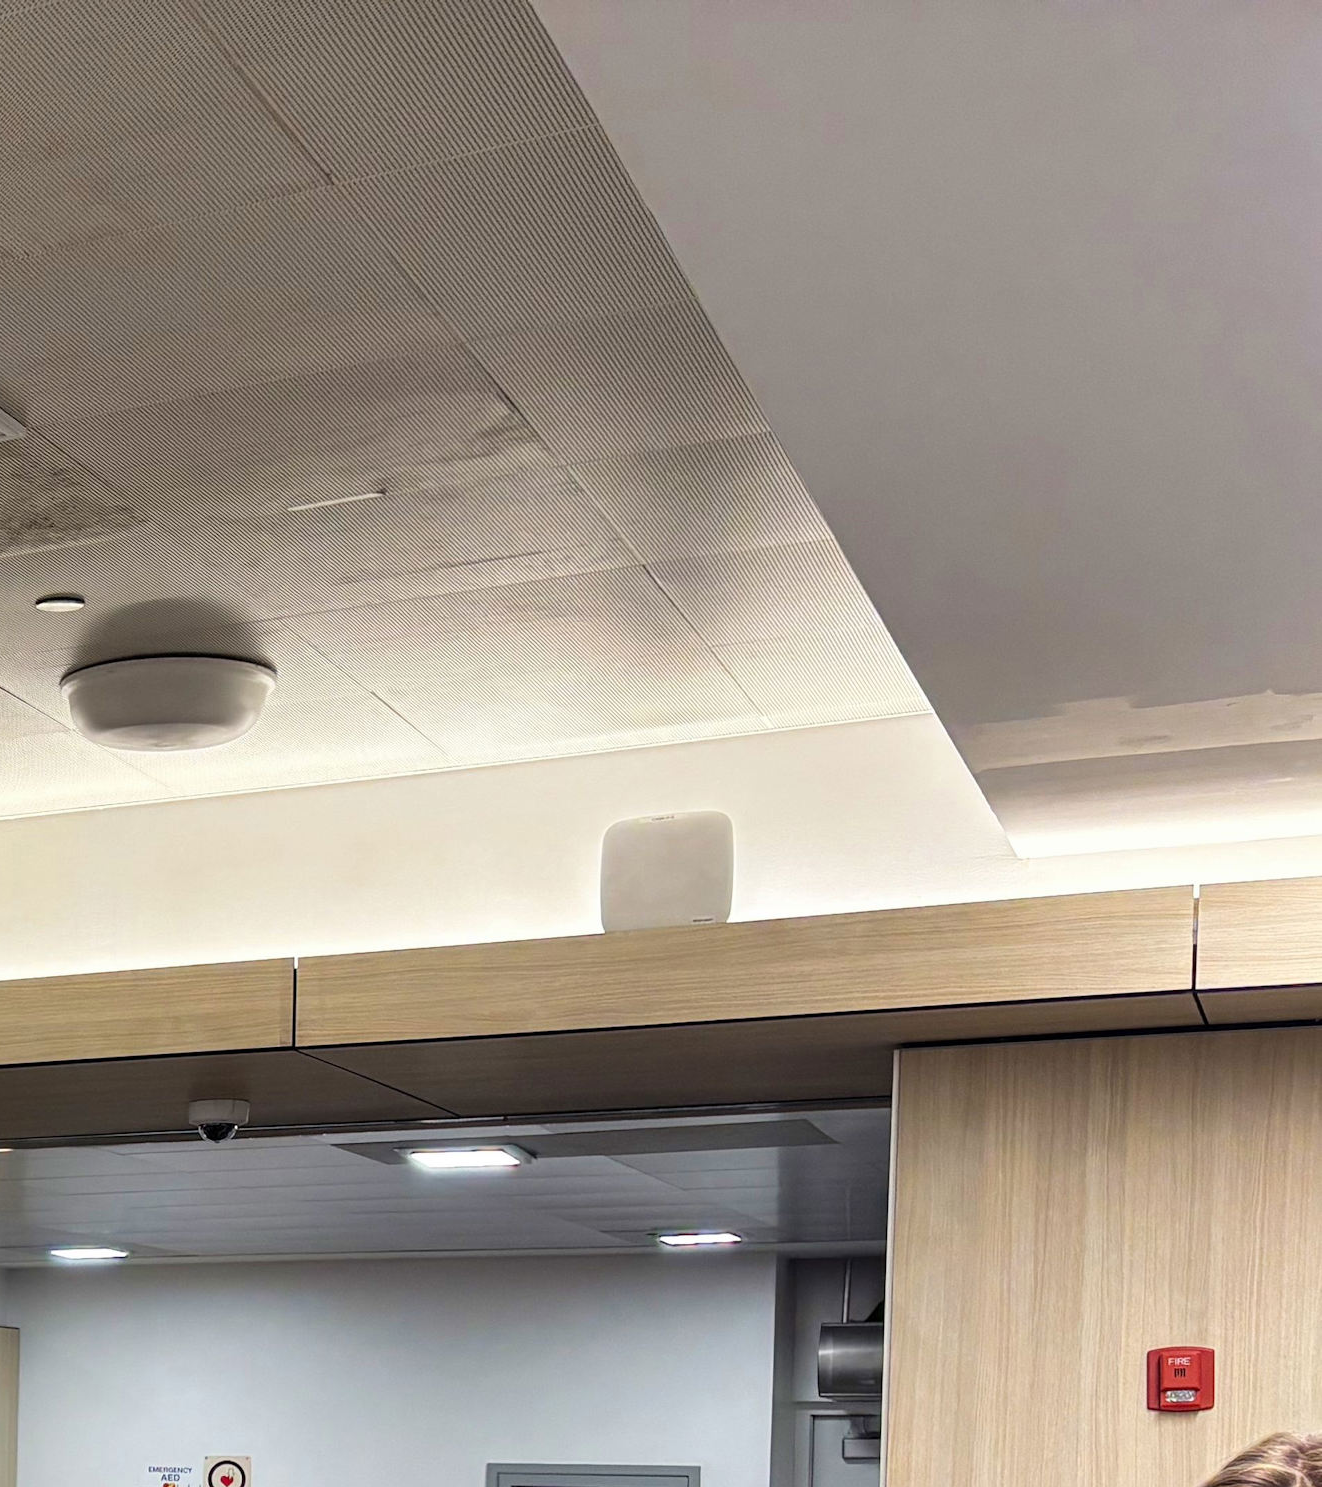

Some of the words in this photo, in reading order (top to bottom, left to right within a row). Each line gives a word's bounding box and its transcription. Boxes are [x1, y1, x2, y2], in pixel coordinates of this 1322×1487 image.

[1168, 1357, 1191, 1366] FIRE
[148, 1466, 192, 1474] EMERGENCY
[160, 1474, 180, 1482] AED
